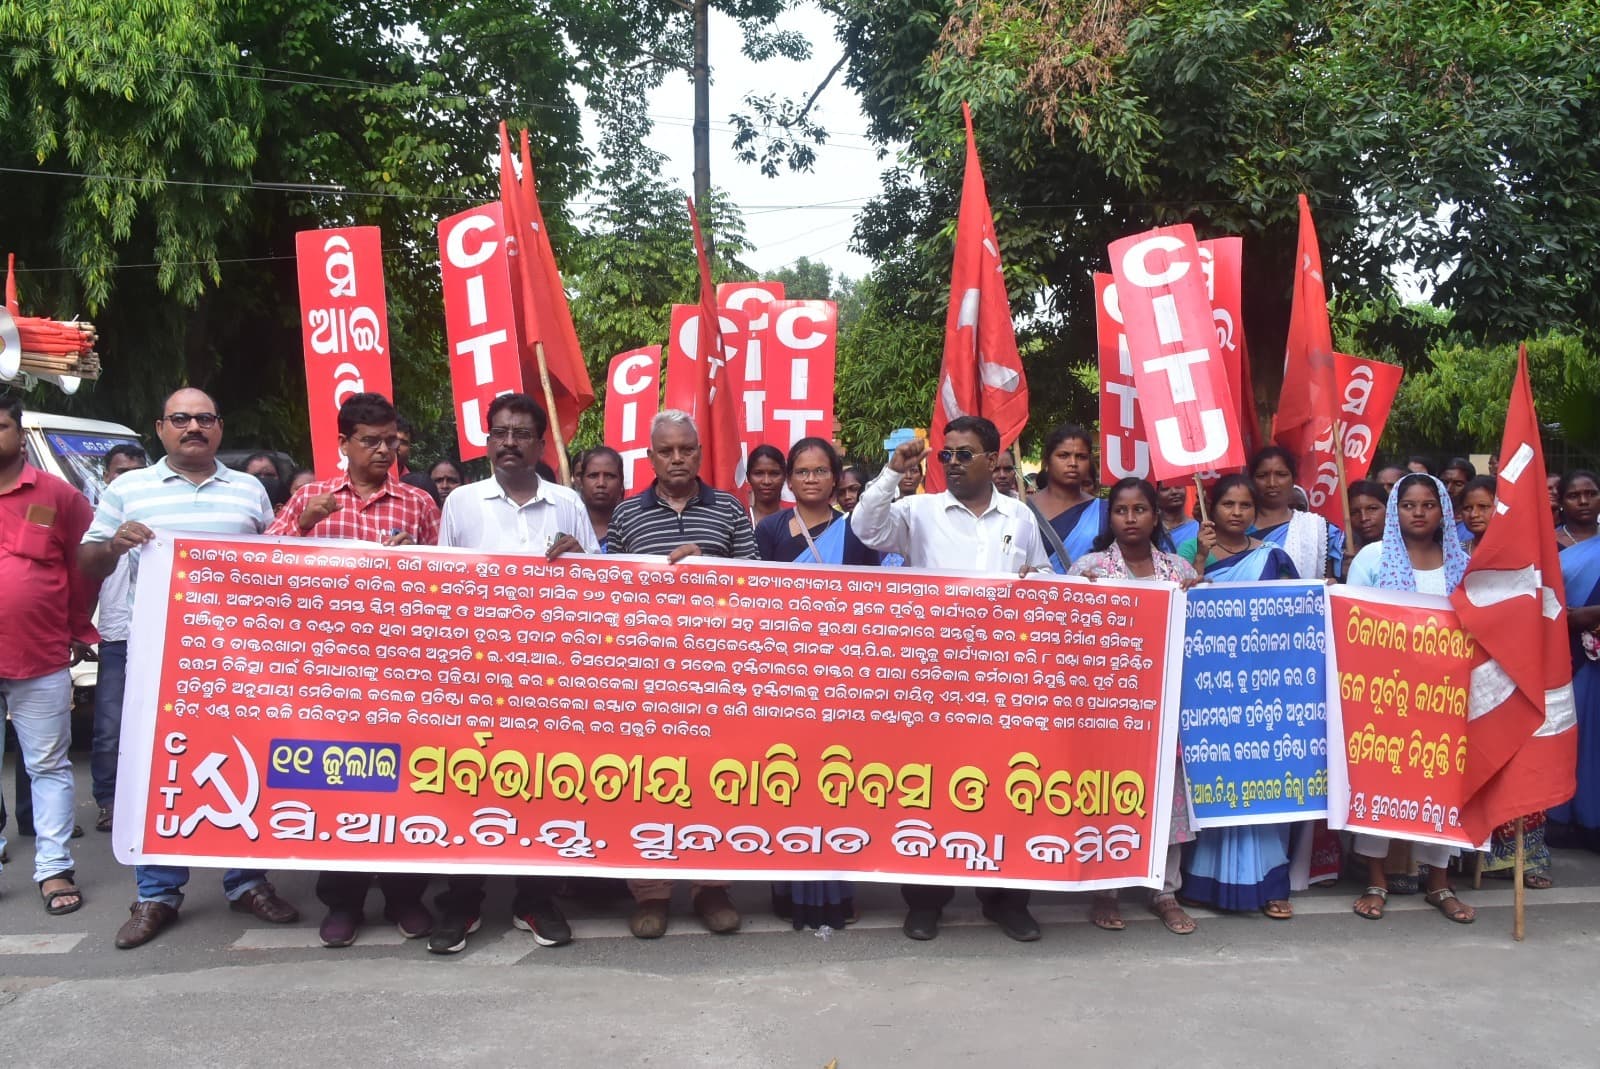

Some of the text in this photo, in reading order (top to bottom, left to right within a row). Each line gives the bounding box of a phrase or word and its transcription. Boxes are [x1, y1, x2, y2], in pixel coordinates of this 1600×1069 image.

[307, 306, 384, 355] ଆଇ
[1122, 235, 1229, 467] CITU
[1346, 605, 1407, 653] ଠିକାଦାର
[1251, 668, 1281, 691] ପ୍ରଦାନ
[1283, 667, 1304, 687] କର
[1306, 666, 1317, 685] ଓ
[323, 745, 397, 785] ଜୁଲାଇ
[408, 731, 1145, 817] ସର୍ବଭାରତୀୟ ଦାବି ଦିବସ ଓ ବିକ୍ଷୋଭ
[1234, 740, 1270, 761] କଲେଜ
[629, 822, 869, 859] ସୁନ୍ଦରଗଡ
[890, 818, 1003, 871] ଜିଲ୍ଲା
[1025, 824, 1140, 863] କମିଟି
